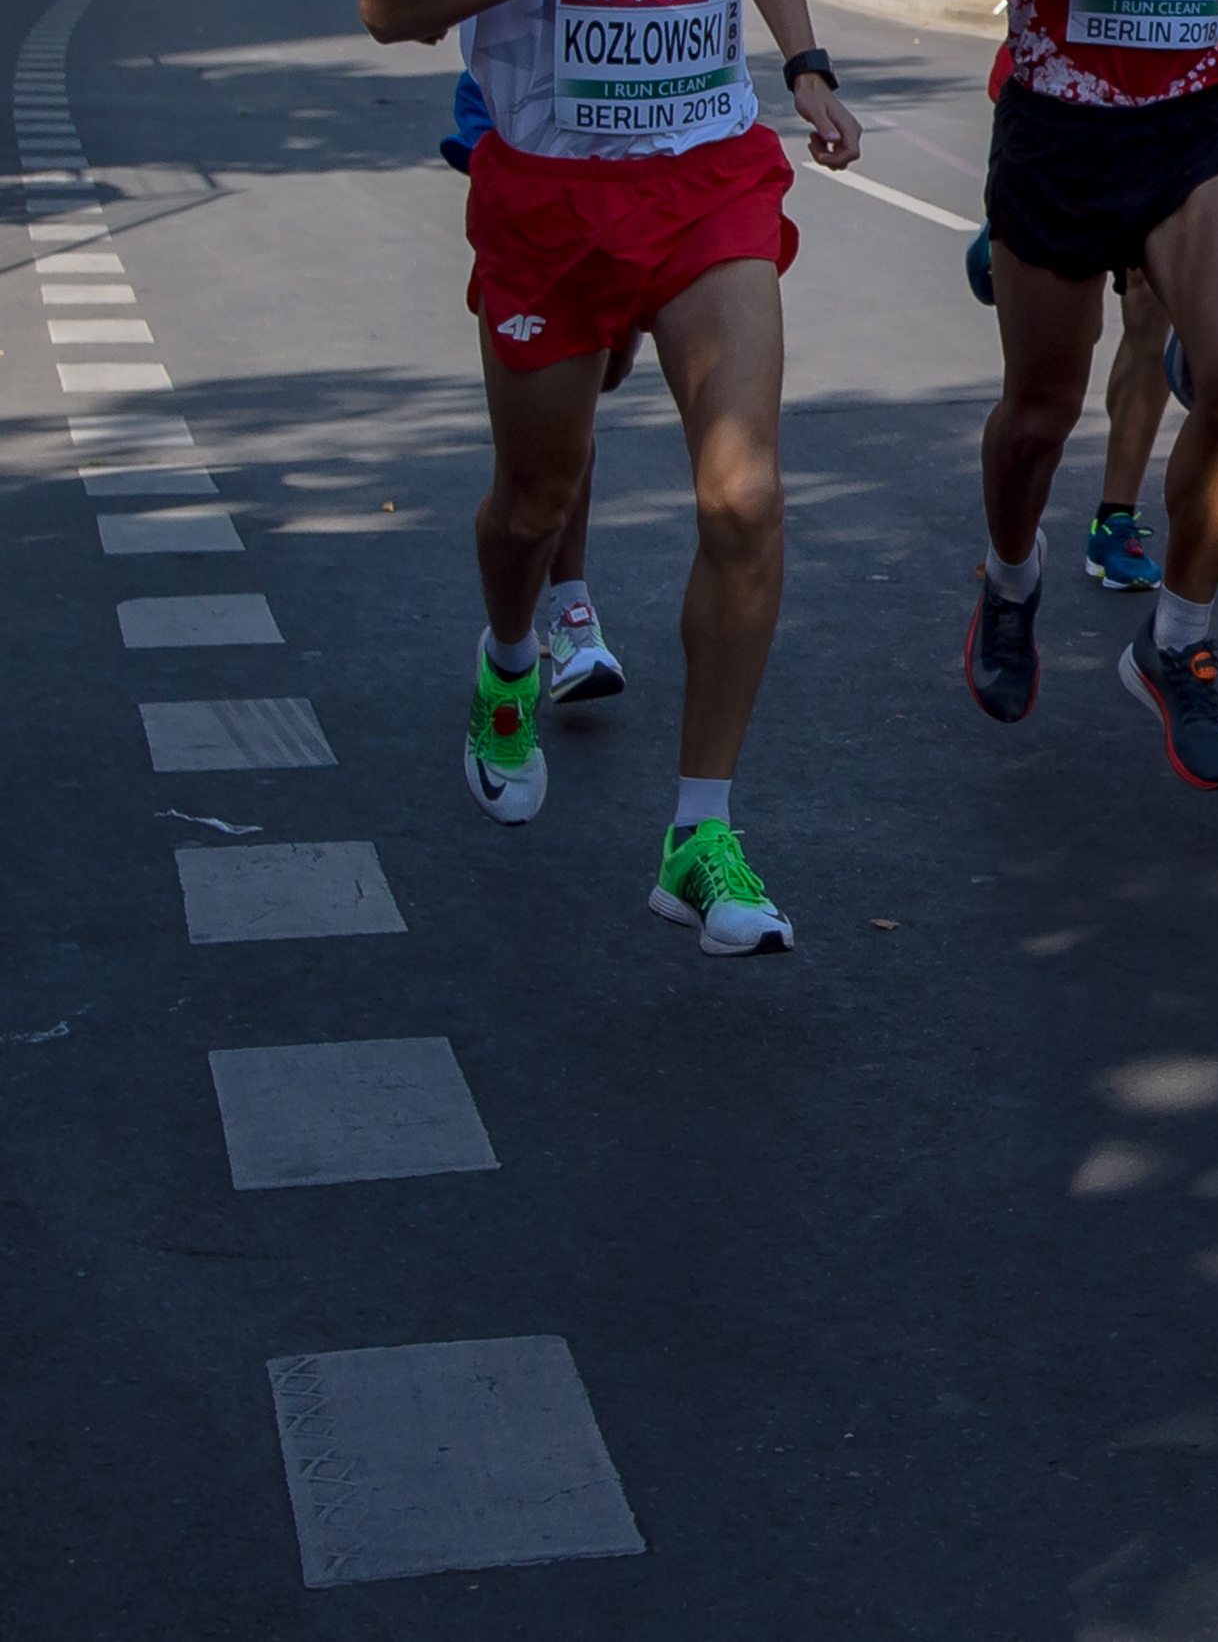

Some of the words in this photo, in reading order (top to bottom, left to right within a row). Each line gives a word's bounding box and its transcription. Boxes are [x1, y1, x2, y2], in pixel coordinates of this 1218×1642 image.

[1120, 0, 1154, 14] RUN
[564, 13, 723, 65] KOZŁOWSKI
[1086, 17, 1172, 43] BERLIN
[1178, 21, 1218, 43] 2018
[614, 83, 653, 98] RUN
[576, 103, 674, 130] BERLIN
[682, 91, 732, 125] 2018
[497, 314, 546, 341] 4F
